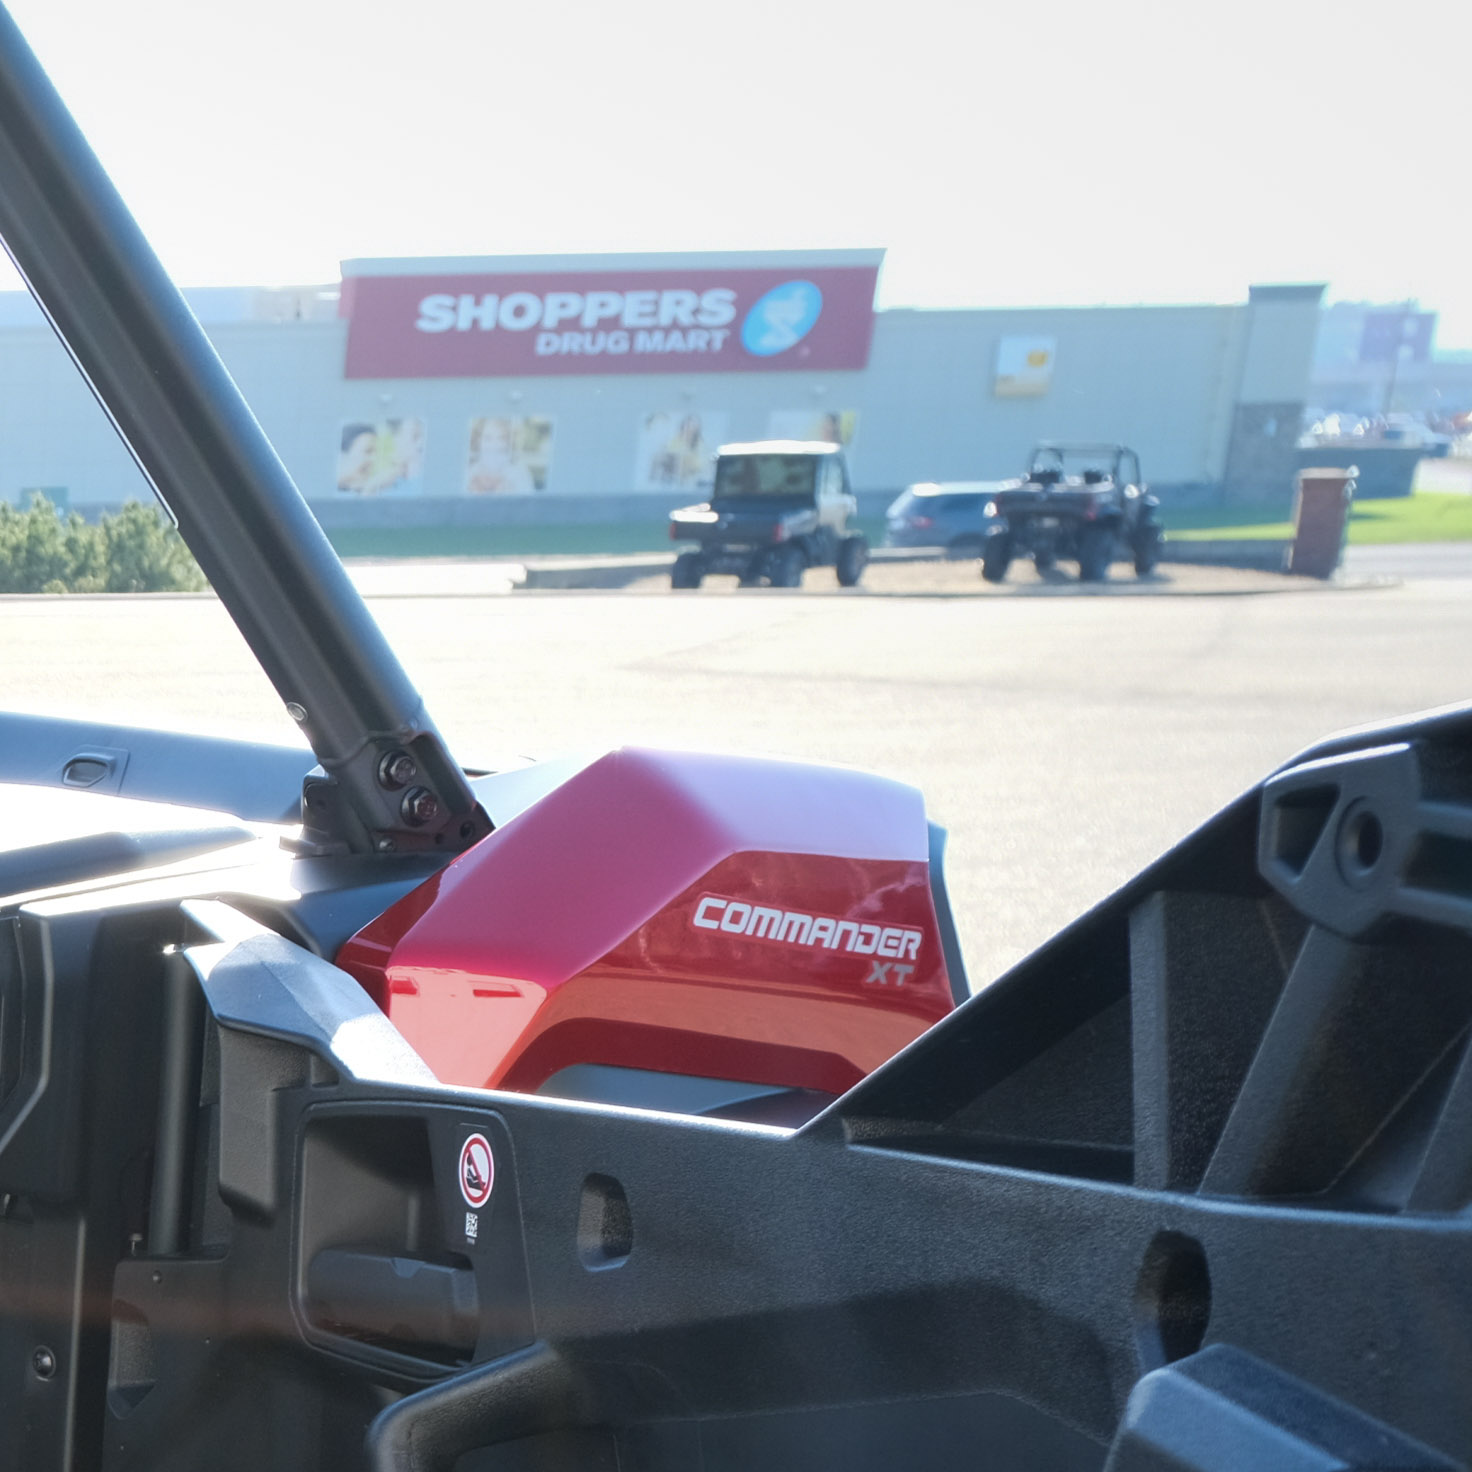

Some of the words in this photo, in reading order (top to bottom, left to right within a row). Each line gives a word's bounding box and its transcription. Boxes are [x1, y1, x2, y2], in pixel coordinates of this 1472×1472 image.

[416, 288, 737, 333] SHOPPERS
[535, 330, 629, 356] DRUG
[634, 328, 730, 355] MART
[693, 897, 922, 960] COMMANDER
[866, 960, 914, 987] XT
